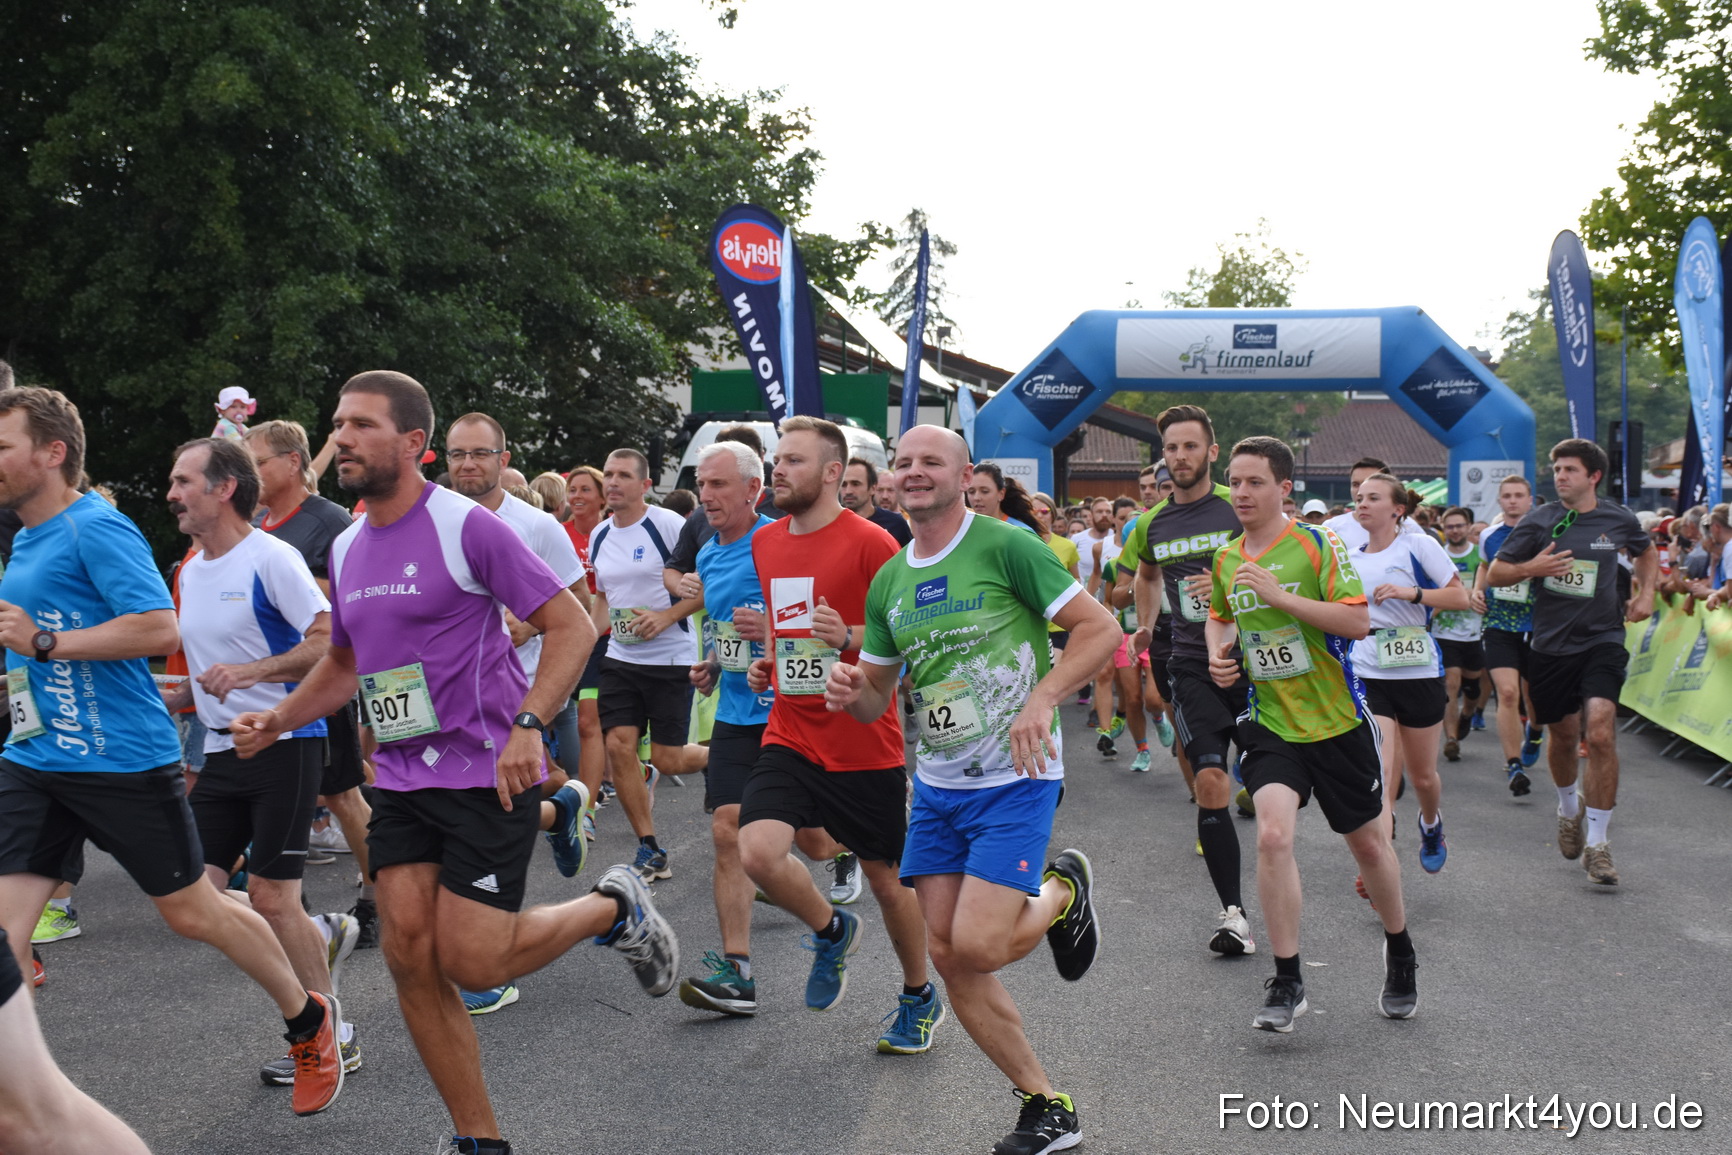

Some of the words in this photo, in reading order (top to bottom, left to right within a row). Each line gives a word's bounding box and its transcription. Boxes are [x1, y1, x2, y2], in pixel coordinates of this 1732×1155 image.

[1241, 331, 1275, 341] Fischer
[1216, 350, 1315, 368] firmenlauf
[1031, 380, 1084, 394] Fischer
[1153, 532, 1230, 560] BOCK
[364, 584, 389, 598] SIND
[390, 583, 421, 595] LILA.
[921, 586, 946, 599] Fischer
[898, 591, 986, 628] firmenlauf
[929, 624, 979, 643] Firmen
[942, 630, 989, 655] länger!
[1256, 646, 1293, 667] 316
[1384, 640, 1425, 656] 1843
[785, 659, 823, 679] 525
[371, 693, 409, 723] 907
[86, 700, 107, 756] Nathalies
[928, 705, 956, 732] 42
[950, 722, 975, 737] Norbert
